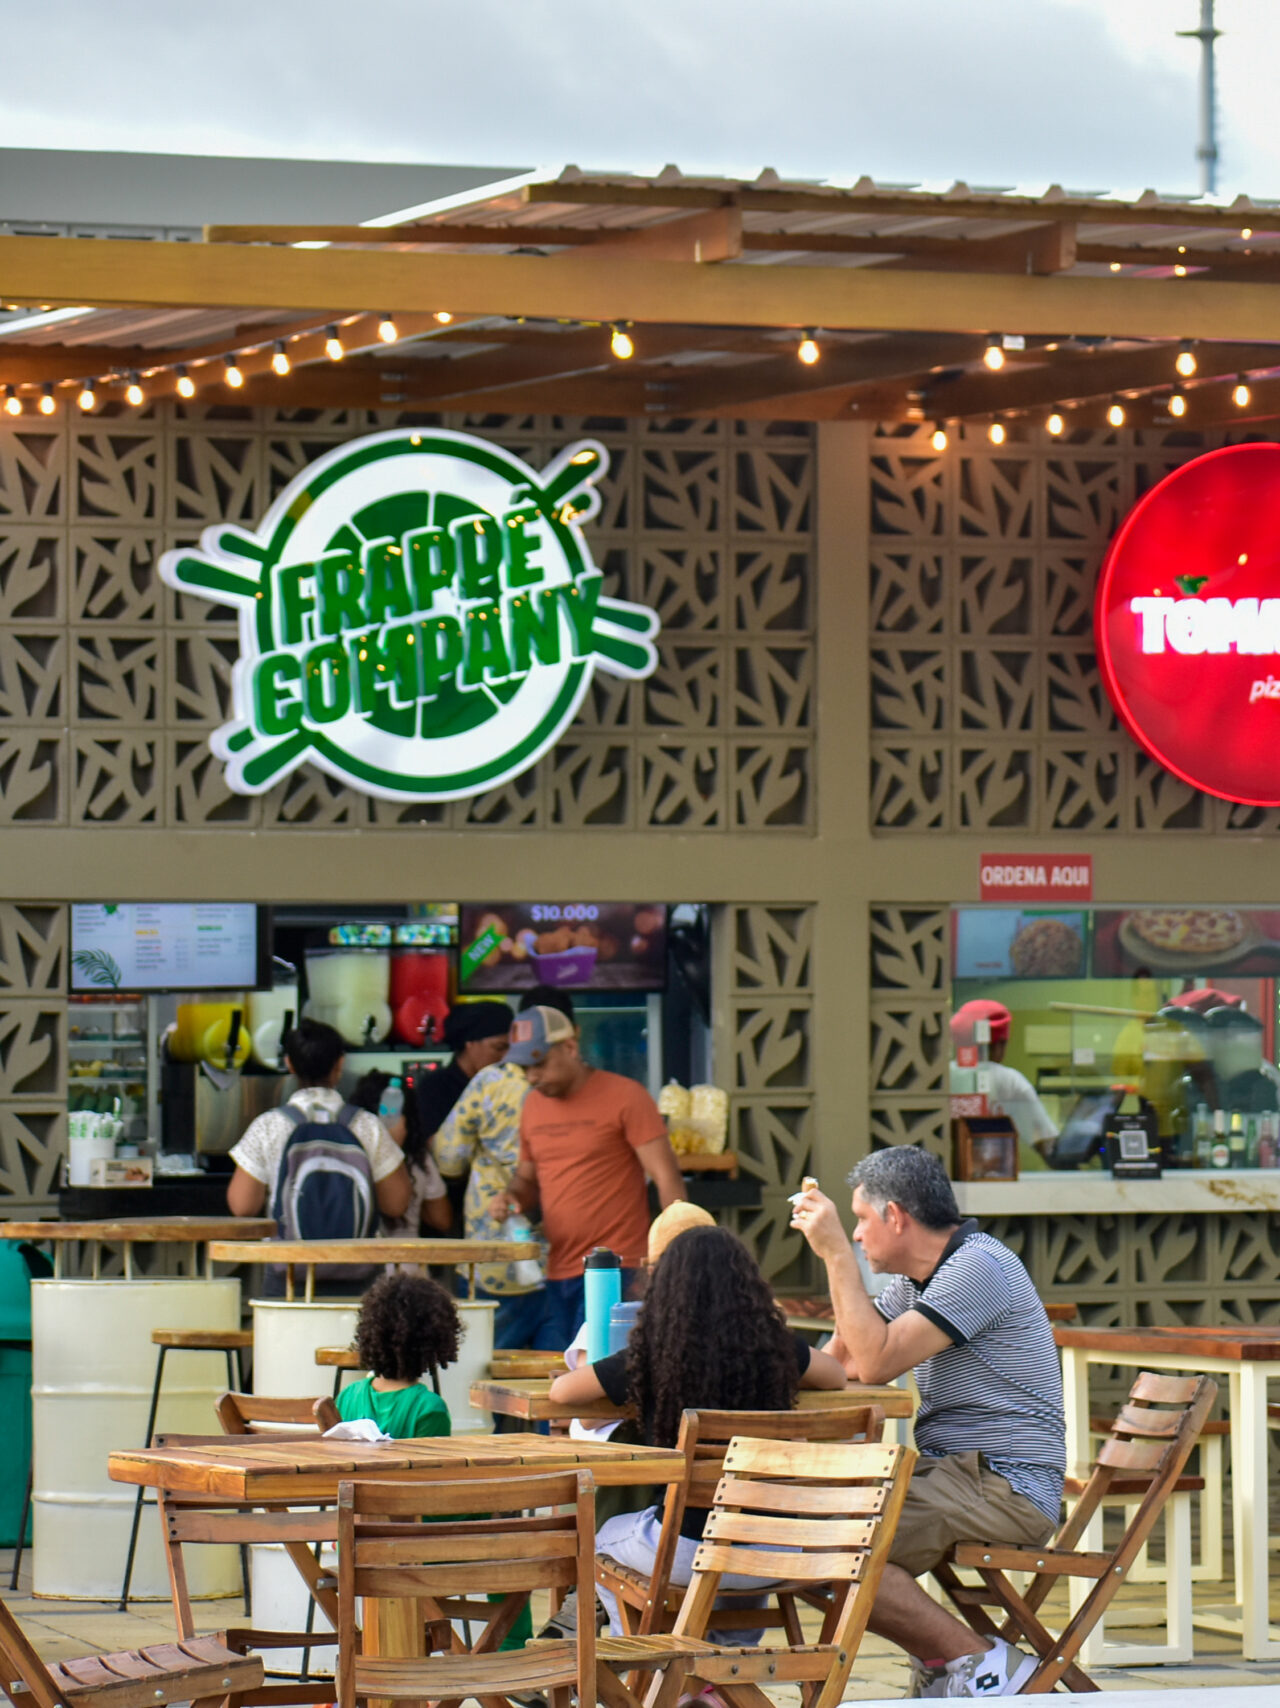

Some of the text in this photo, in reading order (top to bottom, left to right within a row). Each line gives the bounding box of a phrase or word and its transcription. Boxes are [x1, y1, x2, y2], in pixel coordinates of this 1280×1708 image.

[251, 570, 605, 738] COMPANY
[981, 866, 1090, 886] ORDENA AQUI
[530, 904, 598, 921] $10.000
[468, 934, 495, 962] NEW
